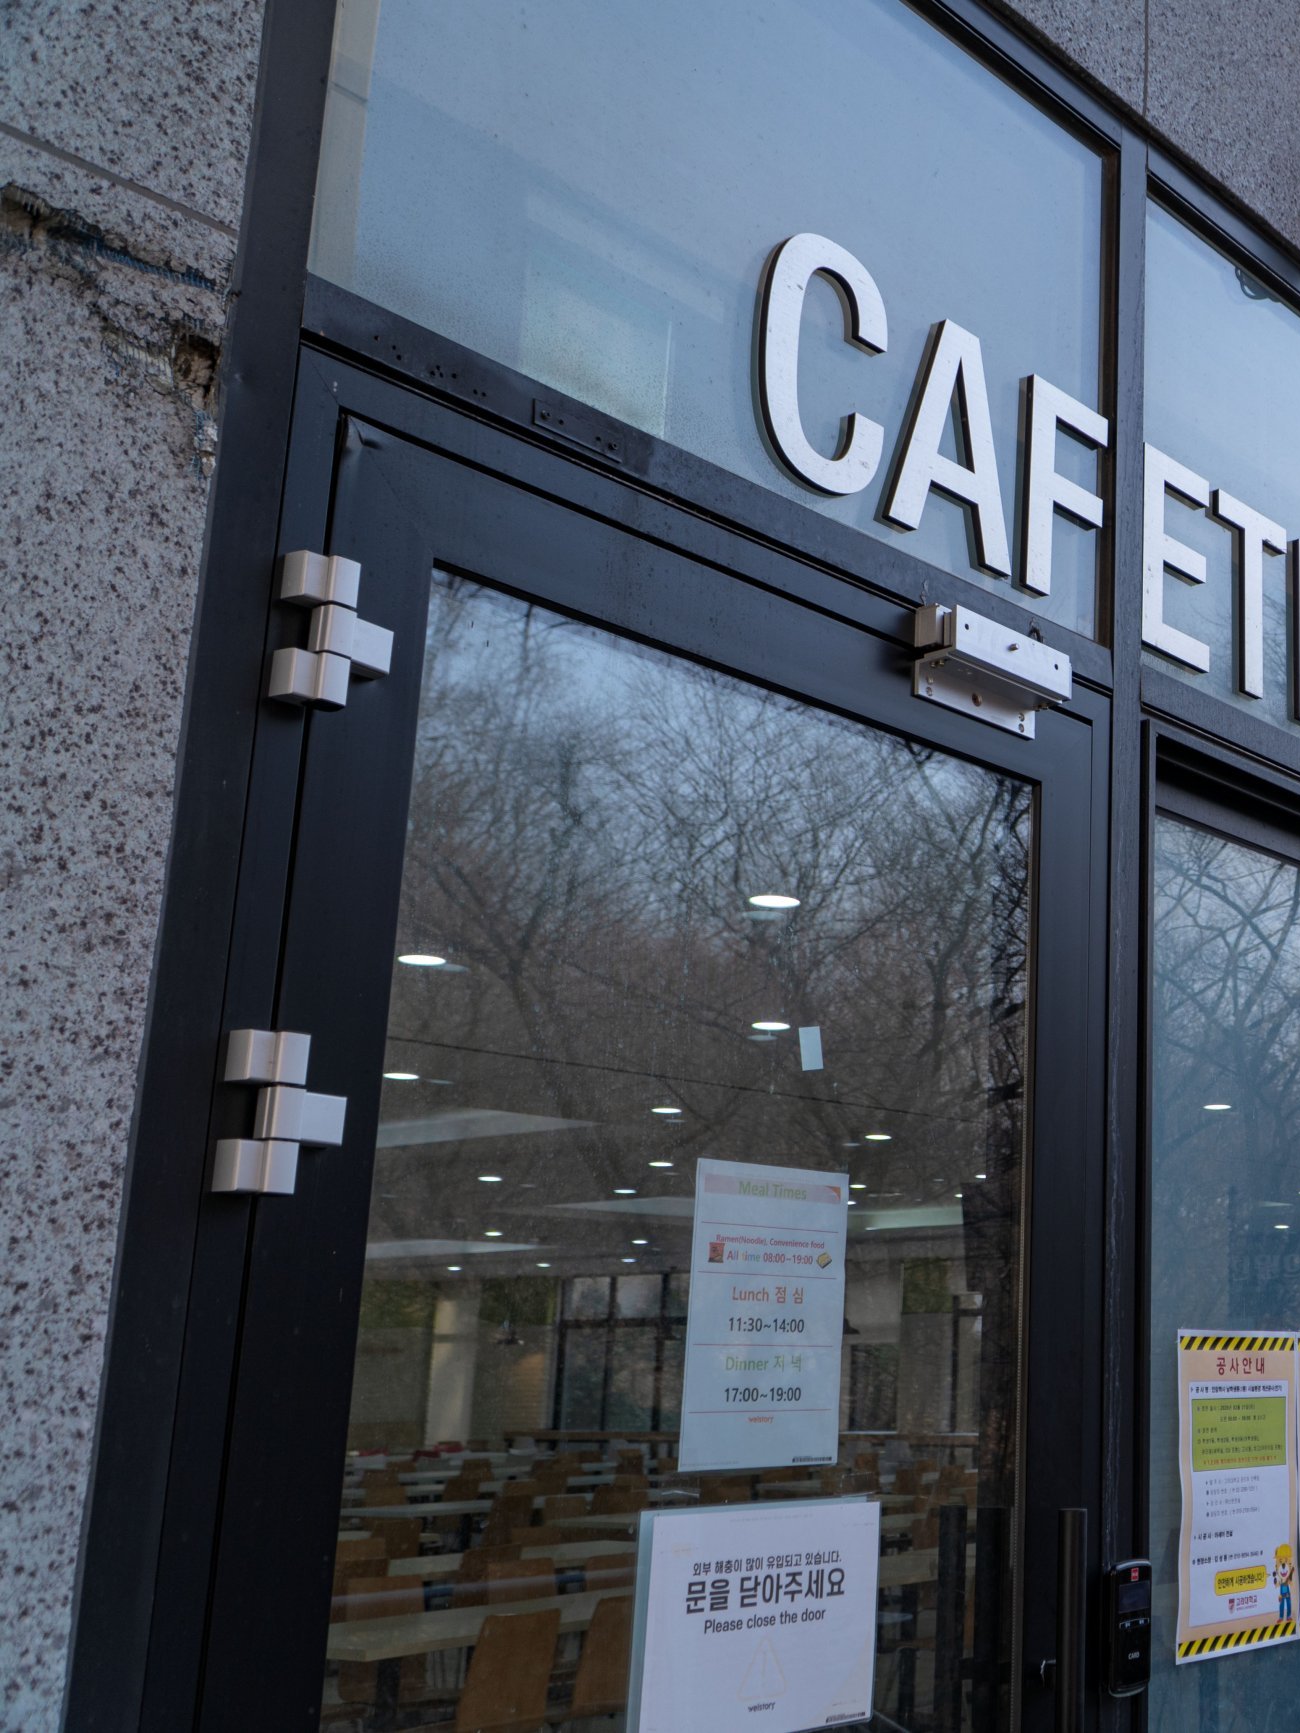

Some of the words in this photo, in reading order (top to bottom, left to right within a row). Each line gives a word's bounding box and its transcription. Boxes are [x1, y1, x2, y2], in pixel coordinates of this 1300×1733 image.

[738, 1181, 769, 1196] Meal
[772, 1184, 808, 1200] Times
[769, 1238, 809, 1249] Convenience
[810, 1241, 825, 1249] food
[732, 1286, 769, 1302] Lunch
[729, 1317, 805, 1333] 11:30~14:00
[725, 1356, 769, 1371] Dinner
[1216, 1356, 1265, 1376] 공사안내
[724, 1387, 802, 1402] 17:00~19:00
[693, 1562, 711, 1577] 외부
[714, 1559, 742, 1575] 해충이
[745, 1556, 763, 1573] 많이
[766, 1553, 802, 1570] 유입되고
[805, 1550, 842, 1566] 있습니다.
[685, 1578, 730, 1615] 문을
[739, 1567, 845, 1609] 닫아주세요
[704, 1619, 743, 1635] Please
[746, 1614, 776, 1630] close
[779, 1610, 798, 1625] the
[801, 1607, 827, 1623] door
